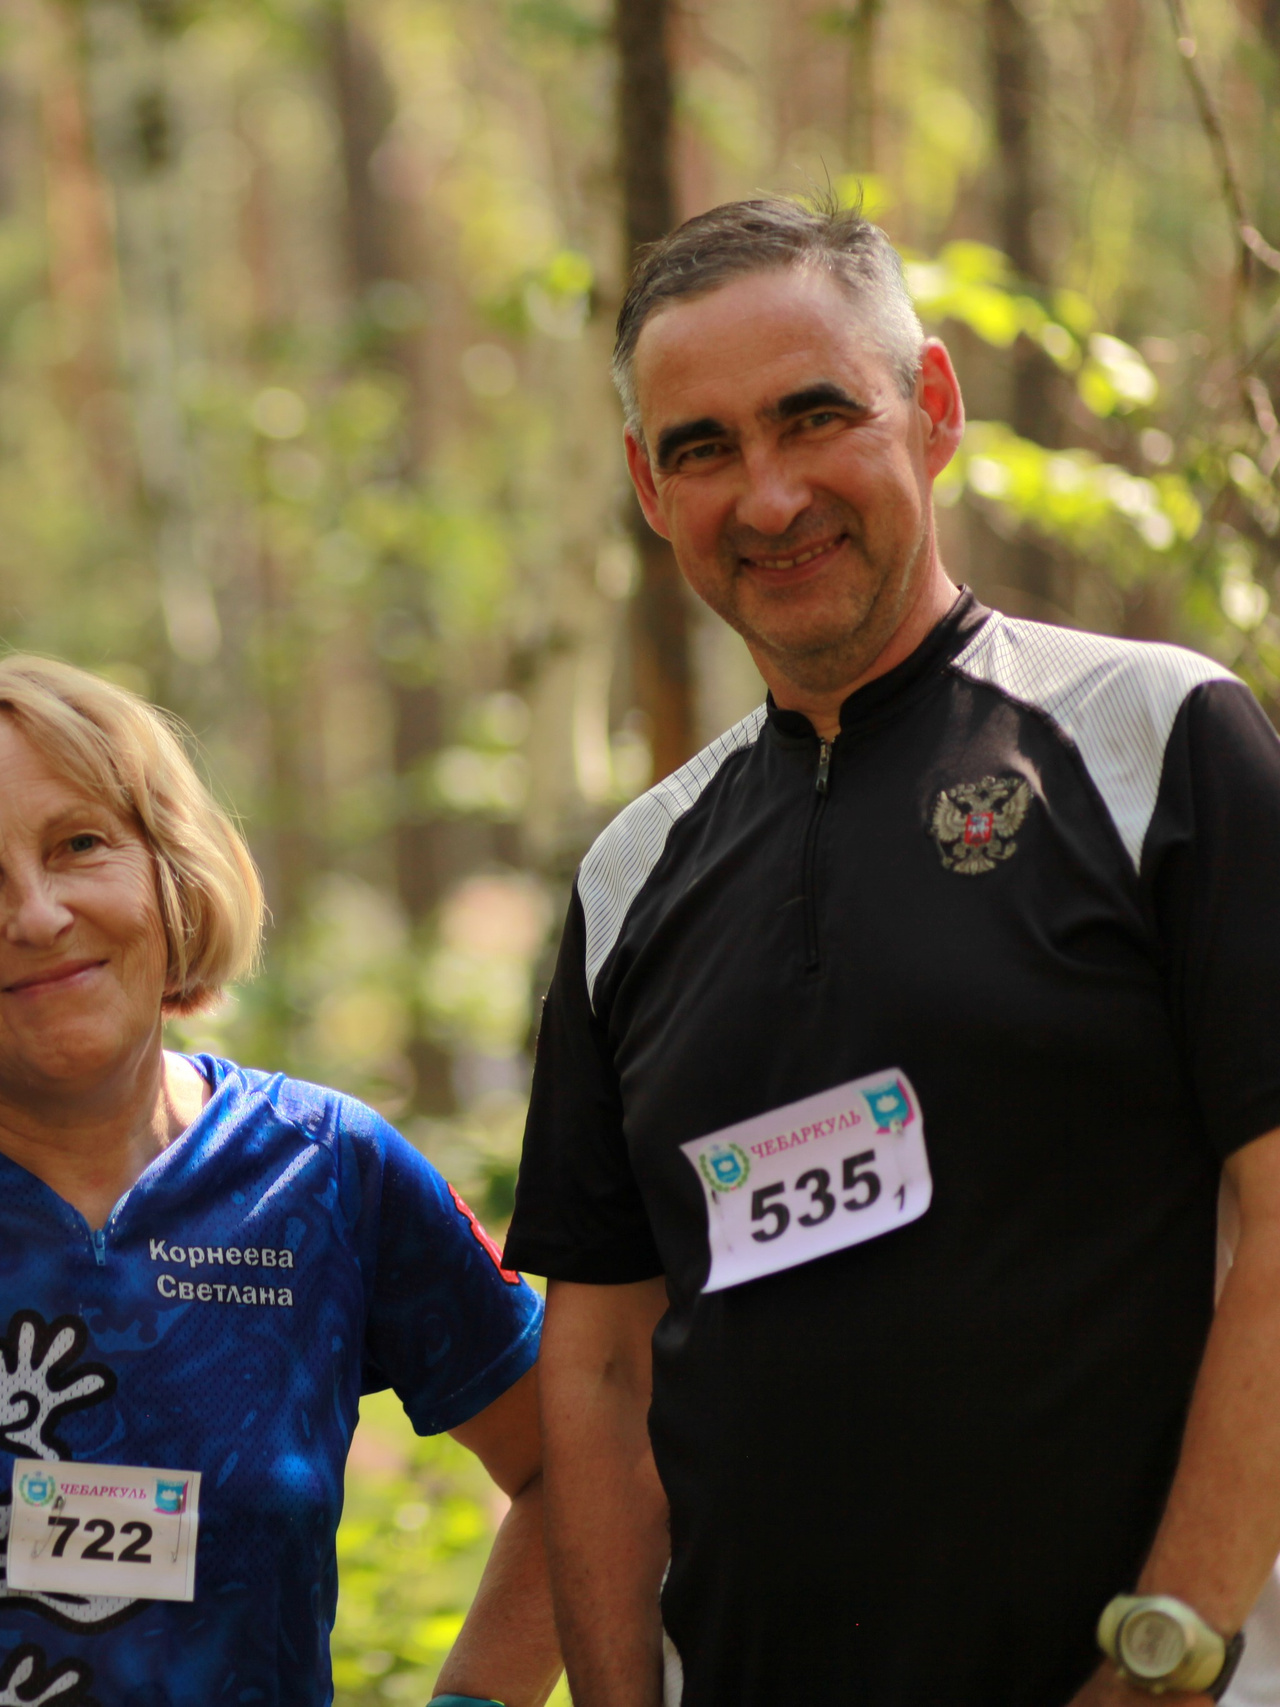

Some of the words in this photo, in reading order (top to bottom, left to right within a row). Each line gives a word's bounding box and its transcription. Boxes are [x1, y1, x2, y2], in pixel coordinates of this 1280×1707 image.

[750, 1109, 862, 1159] ЧЕБАРКУЛЬ
[750, 1148, 882, 1244] 535
[894, 1183, 906, 1213] 1
[149, 1238, 294, 1269] Корнеева
[156, 1274, 294, 1307] Светлана
[59, 1482, 147, 1500] ЧЕБАРКУЛЬ
[47, 1515, 153, 1564] 722
